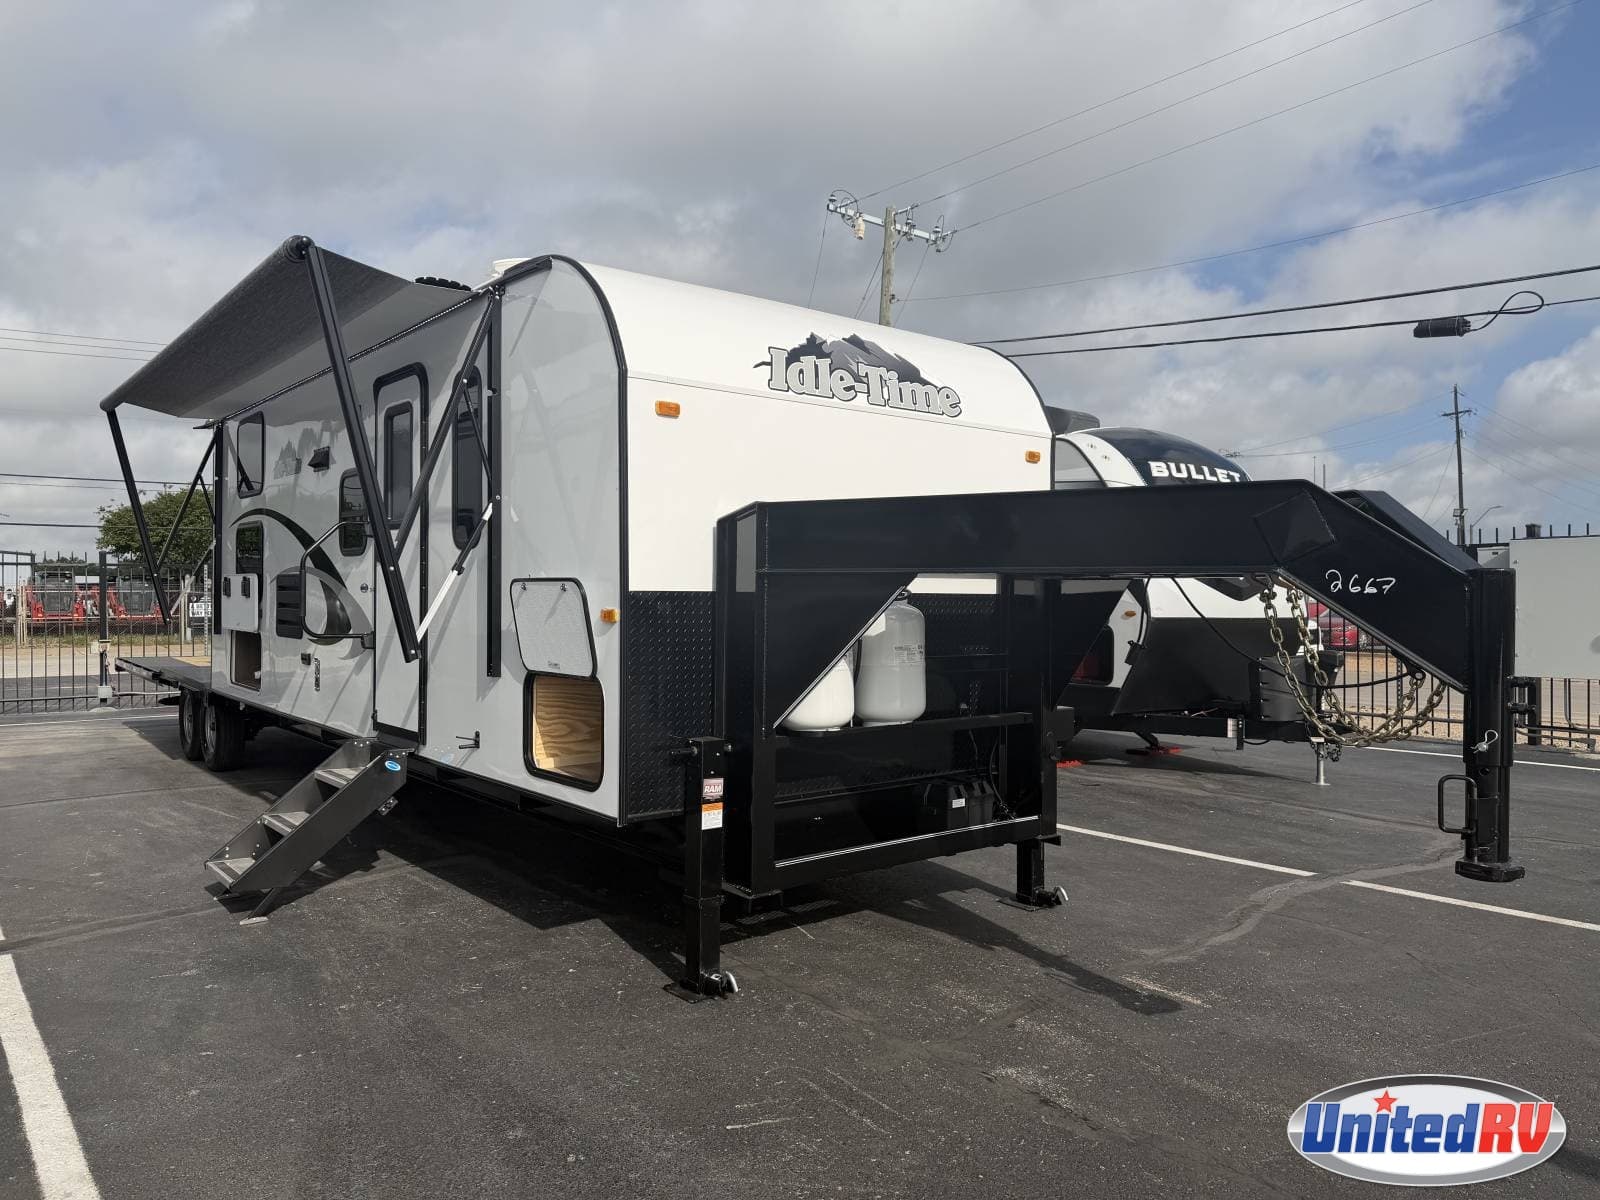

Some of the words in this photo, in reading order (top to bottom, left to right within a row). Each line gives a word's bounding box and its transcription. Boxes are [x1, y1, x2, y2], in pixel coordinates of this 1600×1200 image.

[768, 346, 962, 418] Idle-Time
[1147, 460, 1241, 483] BULLET
[1325, 569, 1396, 595] 2667
[704, 784, 722, 793] RAM
